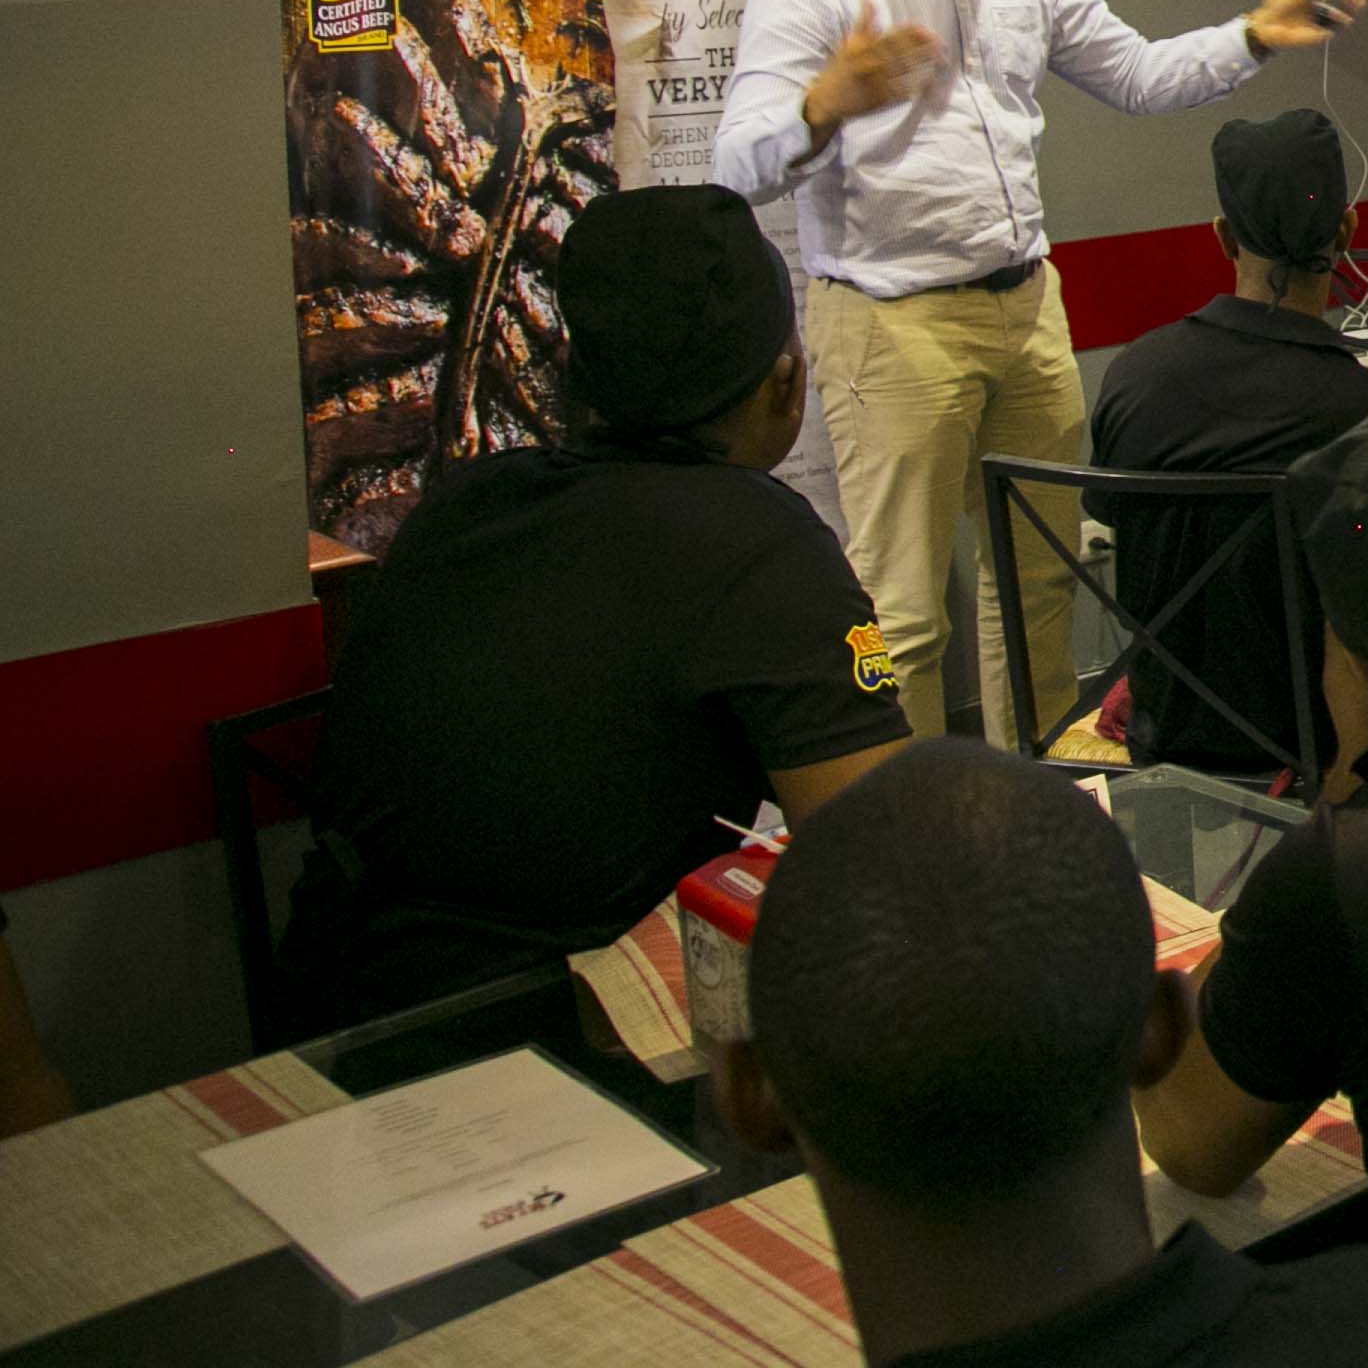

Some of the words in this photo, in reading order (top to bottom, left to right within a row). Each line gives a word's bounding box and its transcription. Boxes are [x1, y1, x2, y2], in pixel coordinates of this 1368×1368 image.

[314, 16, 360, 38] ANGUS
[361, 12, 391, 29] BEEF
[705, 46, 736, 69] TH
[647, 75, 729, 105] VERY
[660, 127, 709, 146] THEN
